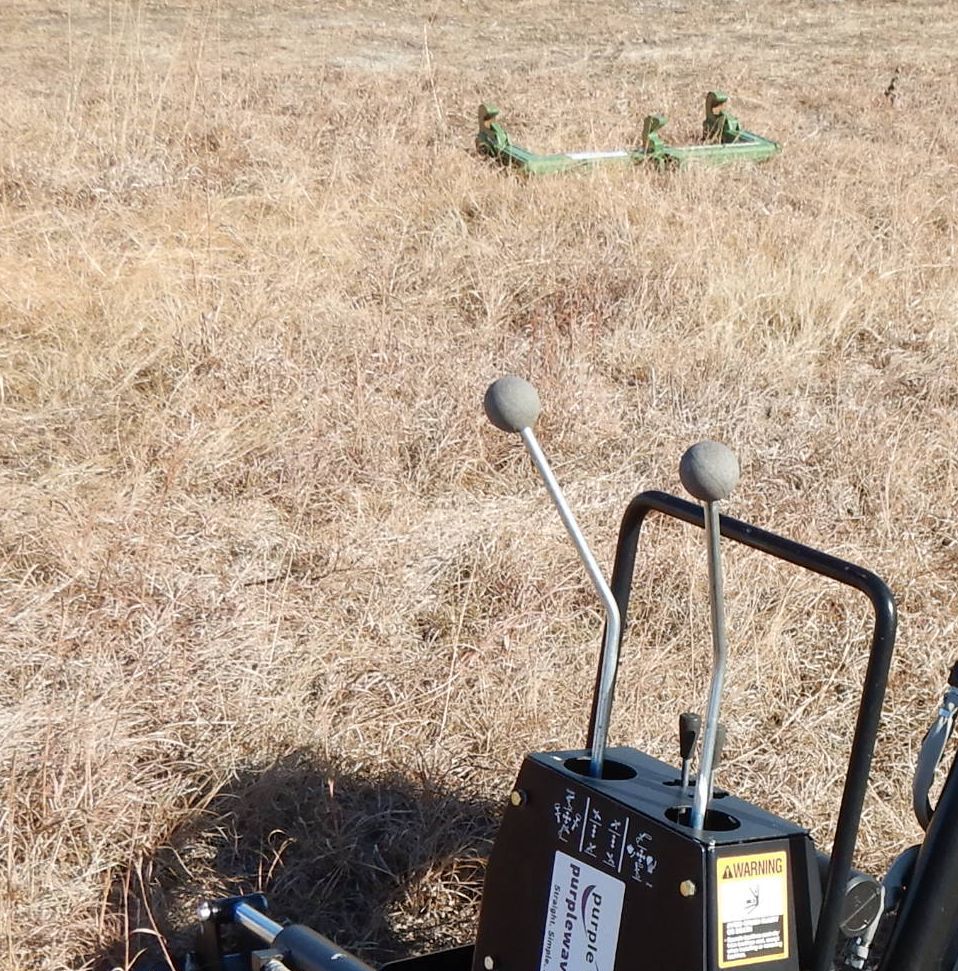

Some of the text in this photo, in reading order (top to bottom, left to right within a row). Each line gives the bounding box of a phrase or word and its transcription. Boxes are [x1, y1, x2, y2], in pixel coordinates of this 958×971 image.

[733, 858, 783, 878] WARNING
[549, 884, 561, 926] Straight.
[586, 891, 602, 964] purple
[544, 930, 555, 967] Simple.
